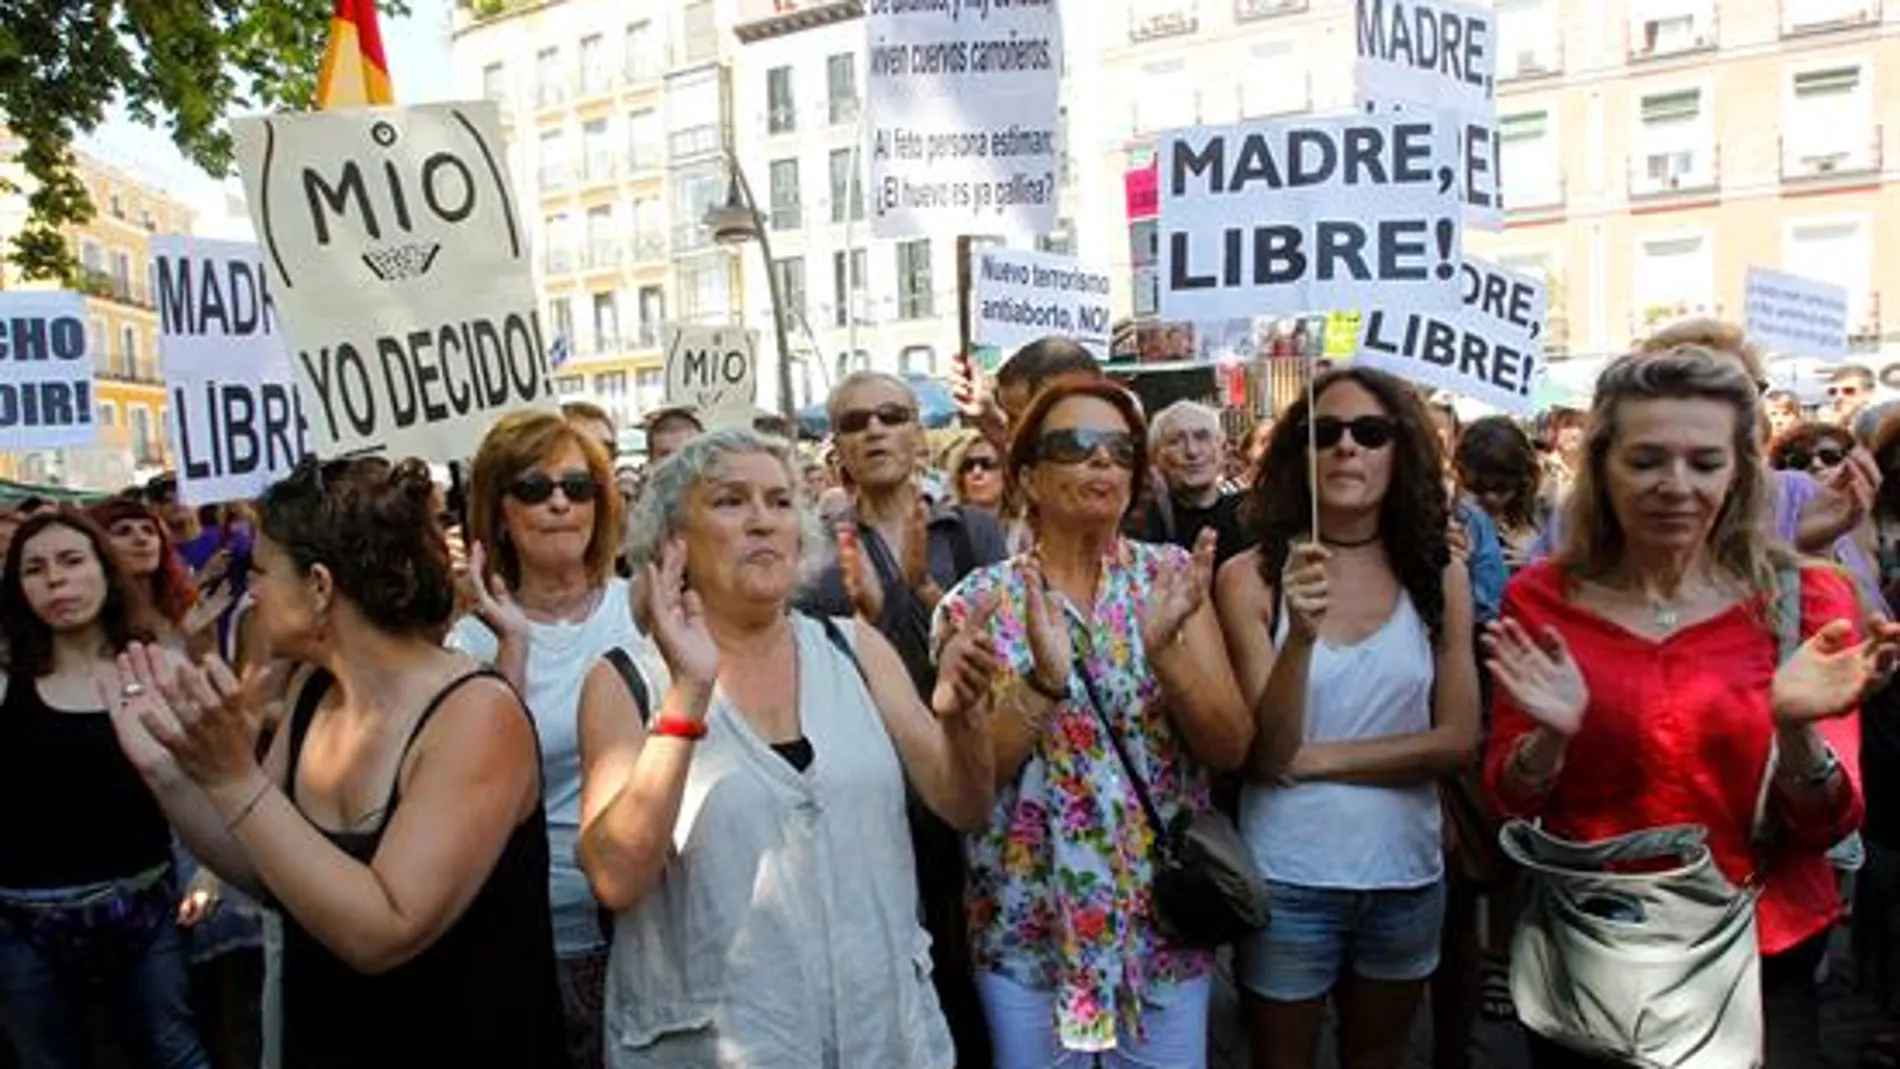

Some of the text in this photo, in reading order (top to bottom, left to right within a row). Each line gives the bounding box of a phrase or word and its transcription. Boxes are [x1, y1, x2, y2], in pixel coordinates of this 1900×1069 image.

[1355, 0, 1493, 98] MADRE,
[1171, 124, 1455, 195] MADRE,
[981, 254, 1110, 295] Nuevo terrorismo
[1170, 217, 1455, 291] LIBRE!
[0, 316, 85, 360] HO
[1460, 262, 1541, 340] DRE,
[300, 309, 554, 442] YO DECIDO!
[1364, 311, 1535, 396] LIBRE!
